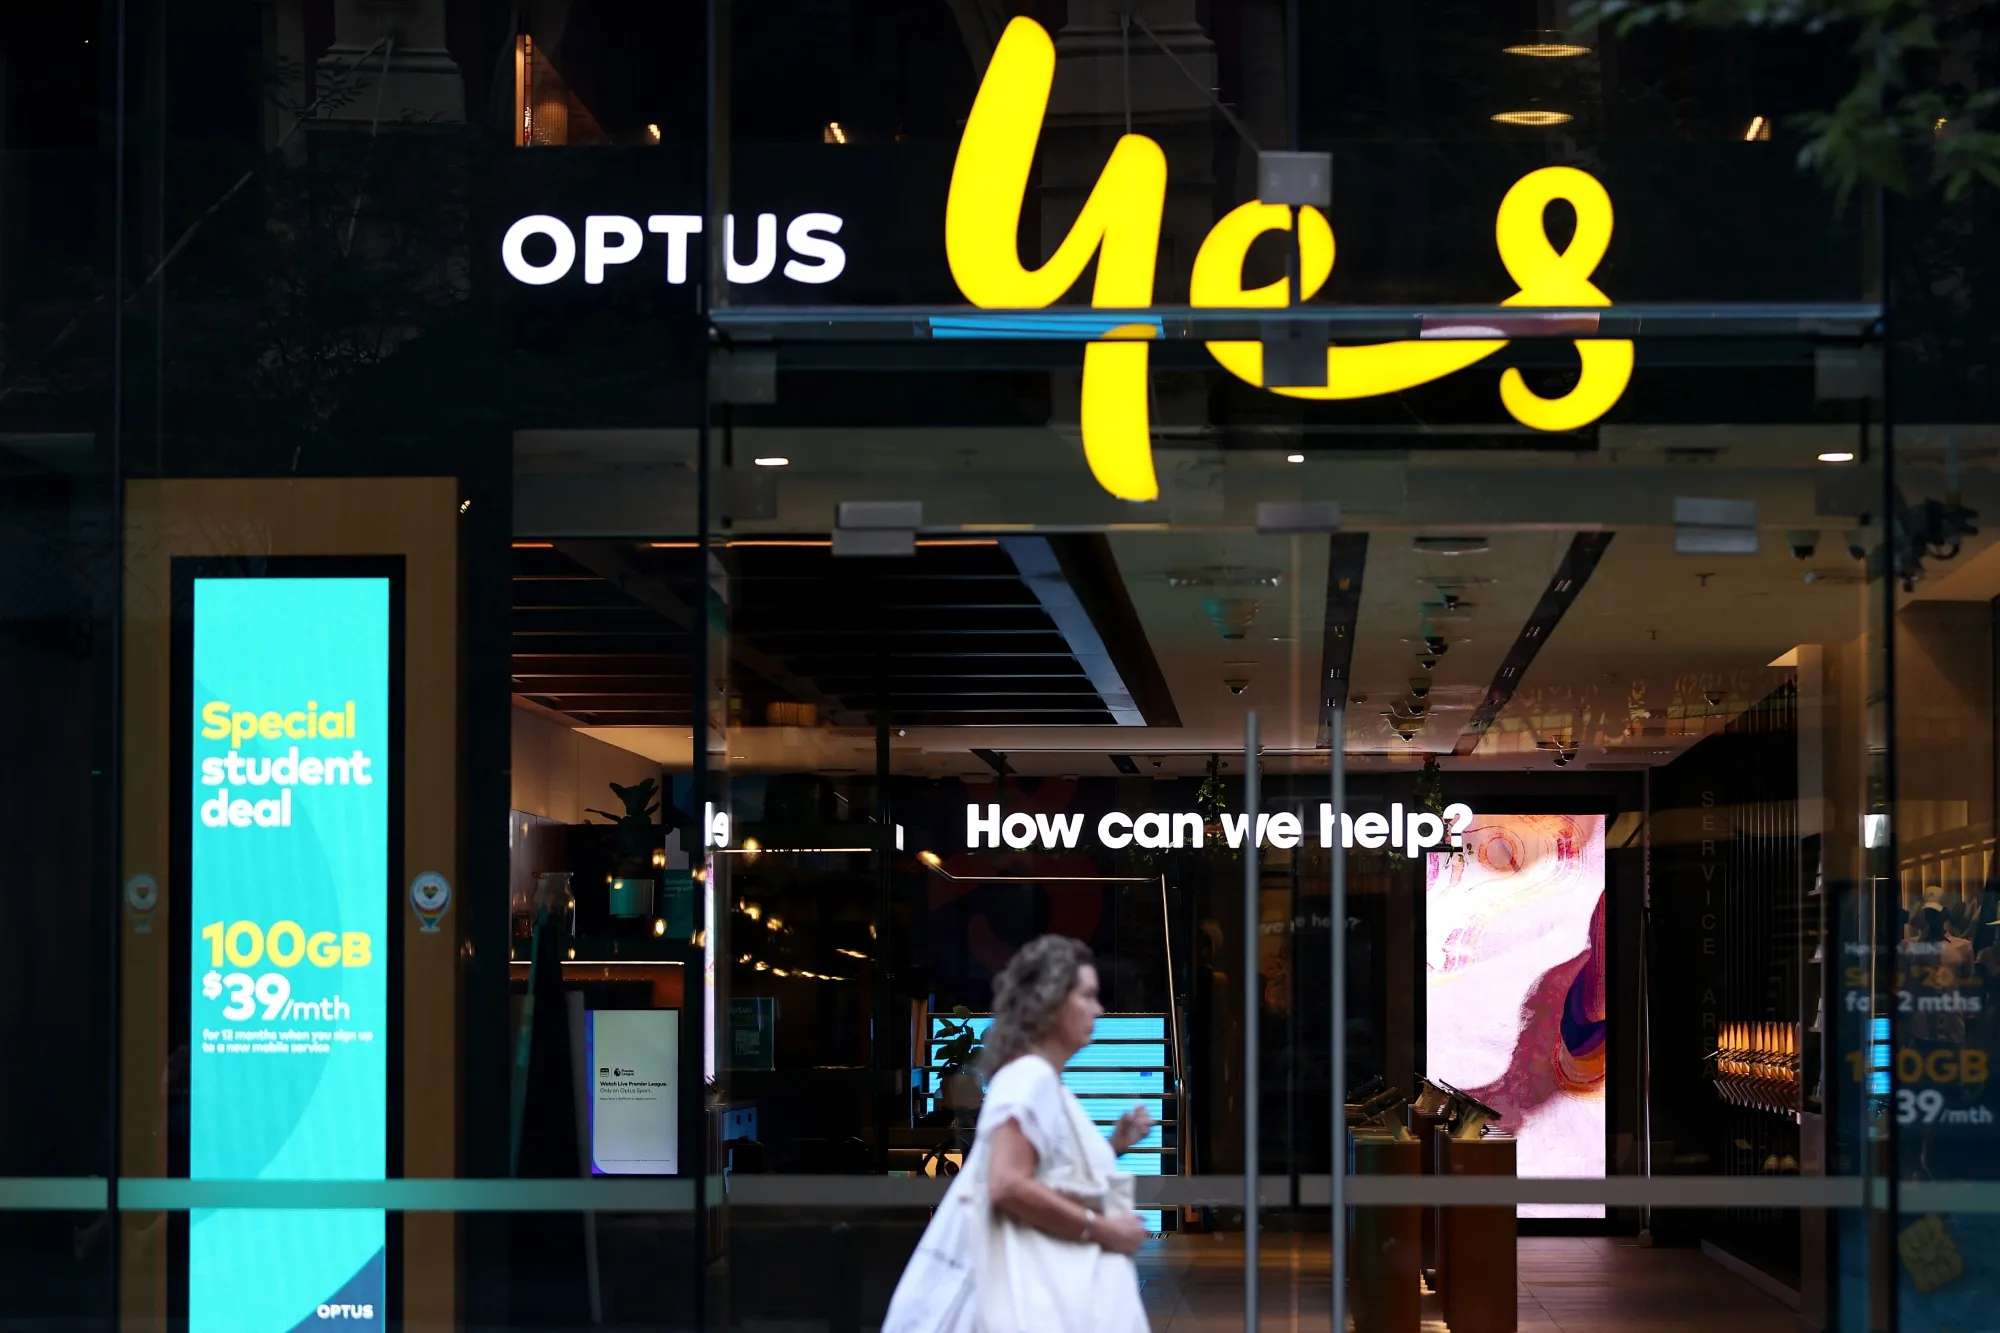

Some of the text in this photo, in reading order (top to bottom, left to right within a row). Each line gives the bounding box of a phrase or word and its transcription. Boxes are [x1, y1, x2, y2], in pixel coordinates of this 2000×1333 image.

[502, 212, 847, 286] OPTUS
[945, 16, 1634, 502] yes
[201, 700, 356, 749] Special
[201, 746, 373, 785] student
[200, 788, 292, 828] deal
[967, 802, 1473, 859] How can we help?
[202, 920, 372, 968] 100GB
[202, 970, 350, 1021] $39/mth
[1917, 990, 1982, 1012] mths
[202, 1029, 220, 1040] for
[234, 1029, 277, 1040] months
[279, 1029, 310, 1040] when
[311, 1031, 332, 1043] you
[202, 1041, 215, 1053] to
[226, 1043, 250, 1053] new
[252, 1040, 289, 1053] mobile
[290, 1041, 330, 1053] service
[1845, 1049, 1989, 1084] 10GB
[1895, 1088, 1993, 1125] 39/mth
[317, 1304, 374, 1320] OPTUS
